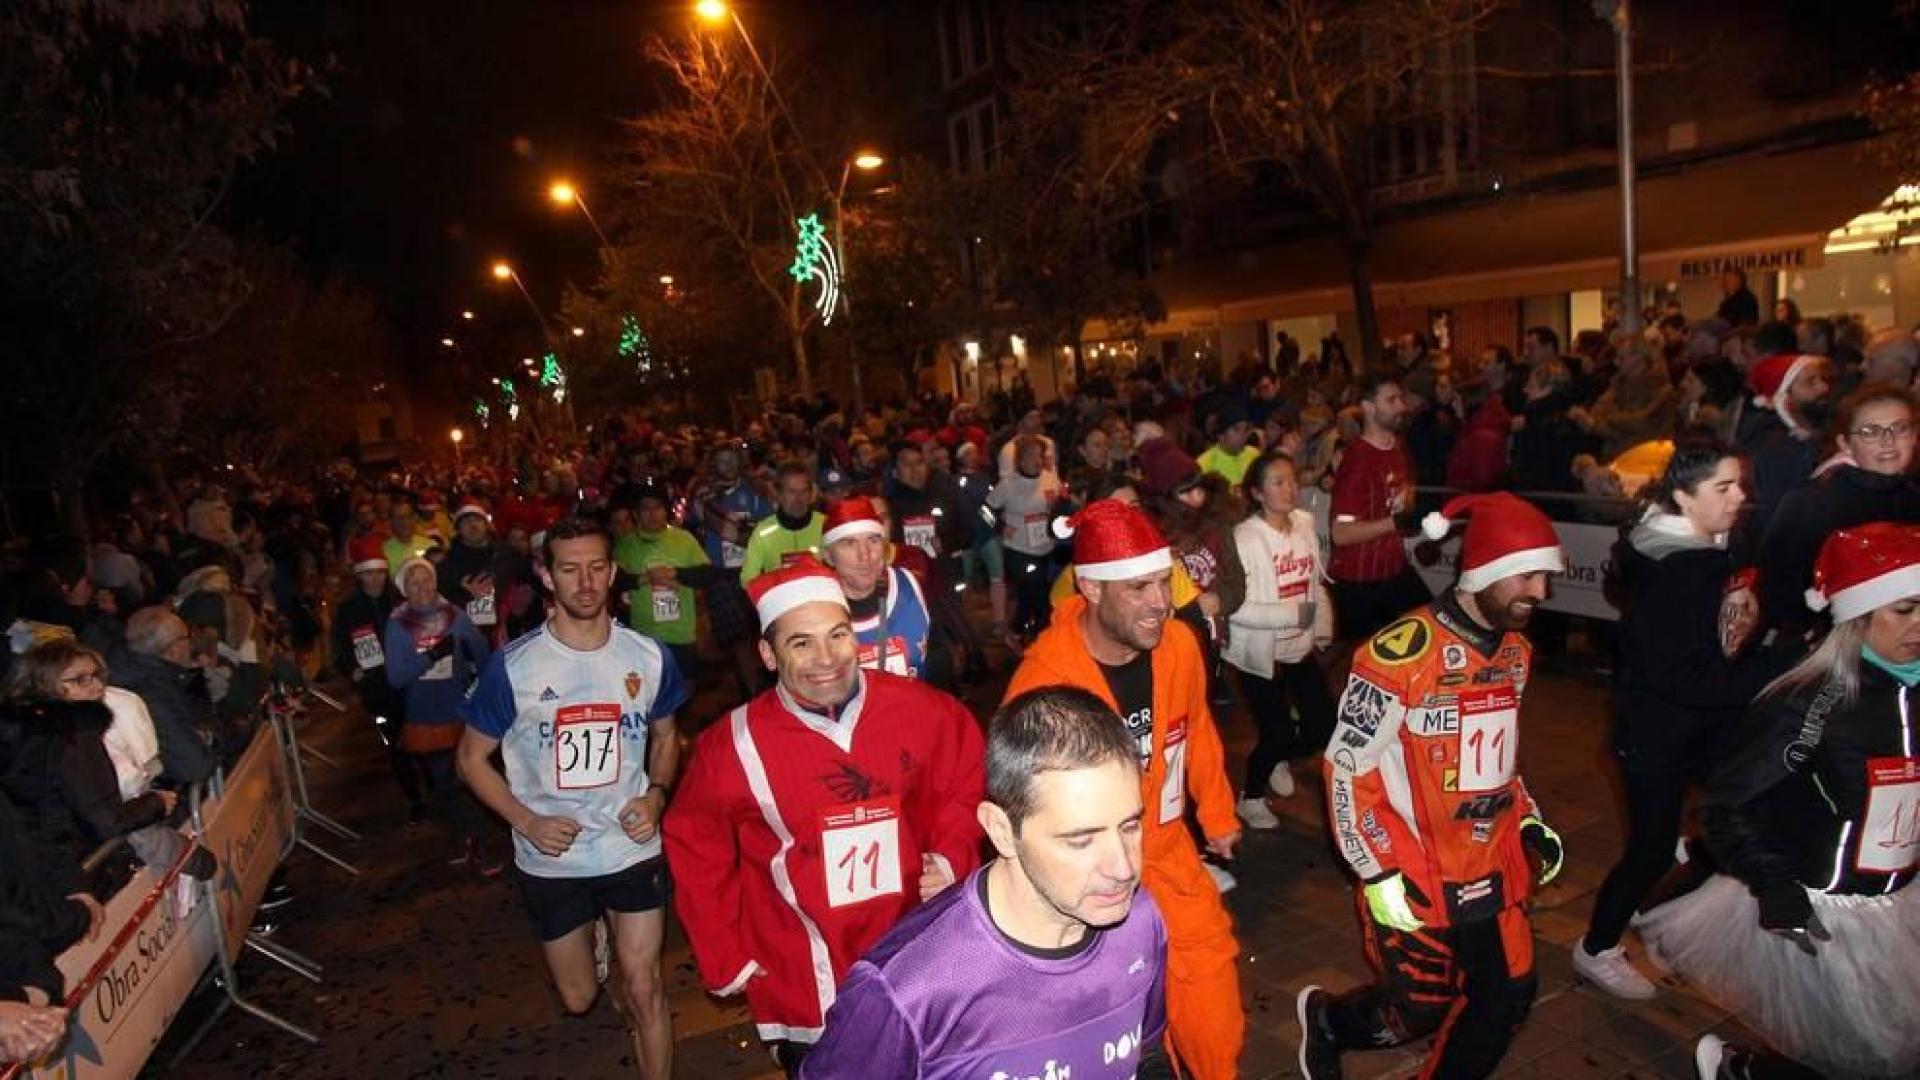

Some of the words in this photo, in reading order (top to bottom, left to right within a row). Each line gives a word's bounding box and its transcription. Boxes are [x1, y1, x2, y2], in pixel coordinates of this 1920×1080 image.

[1681, 248, 1804, 280] RESTAURANTE
[1423, 709, 1458, 732] ME
[558, 727, 614, 773] 317
[1468, 728, 1506, 776] 11
[838, 841, 881, 893] 11
[97, 968, 141, 1023] Obra
[138, 915, 175, 973] Socia
